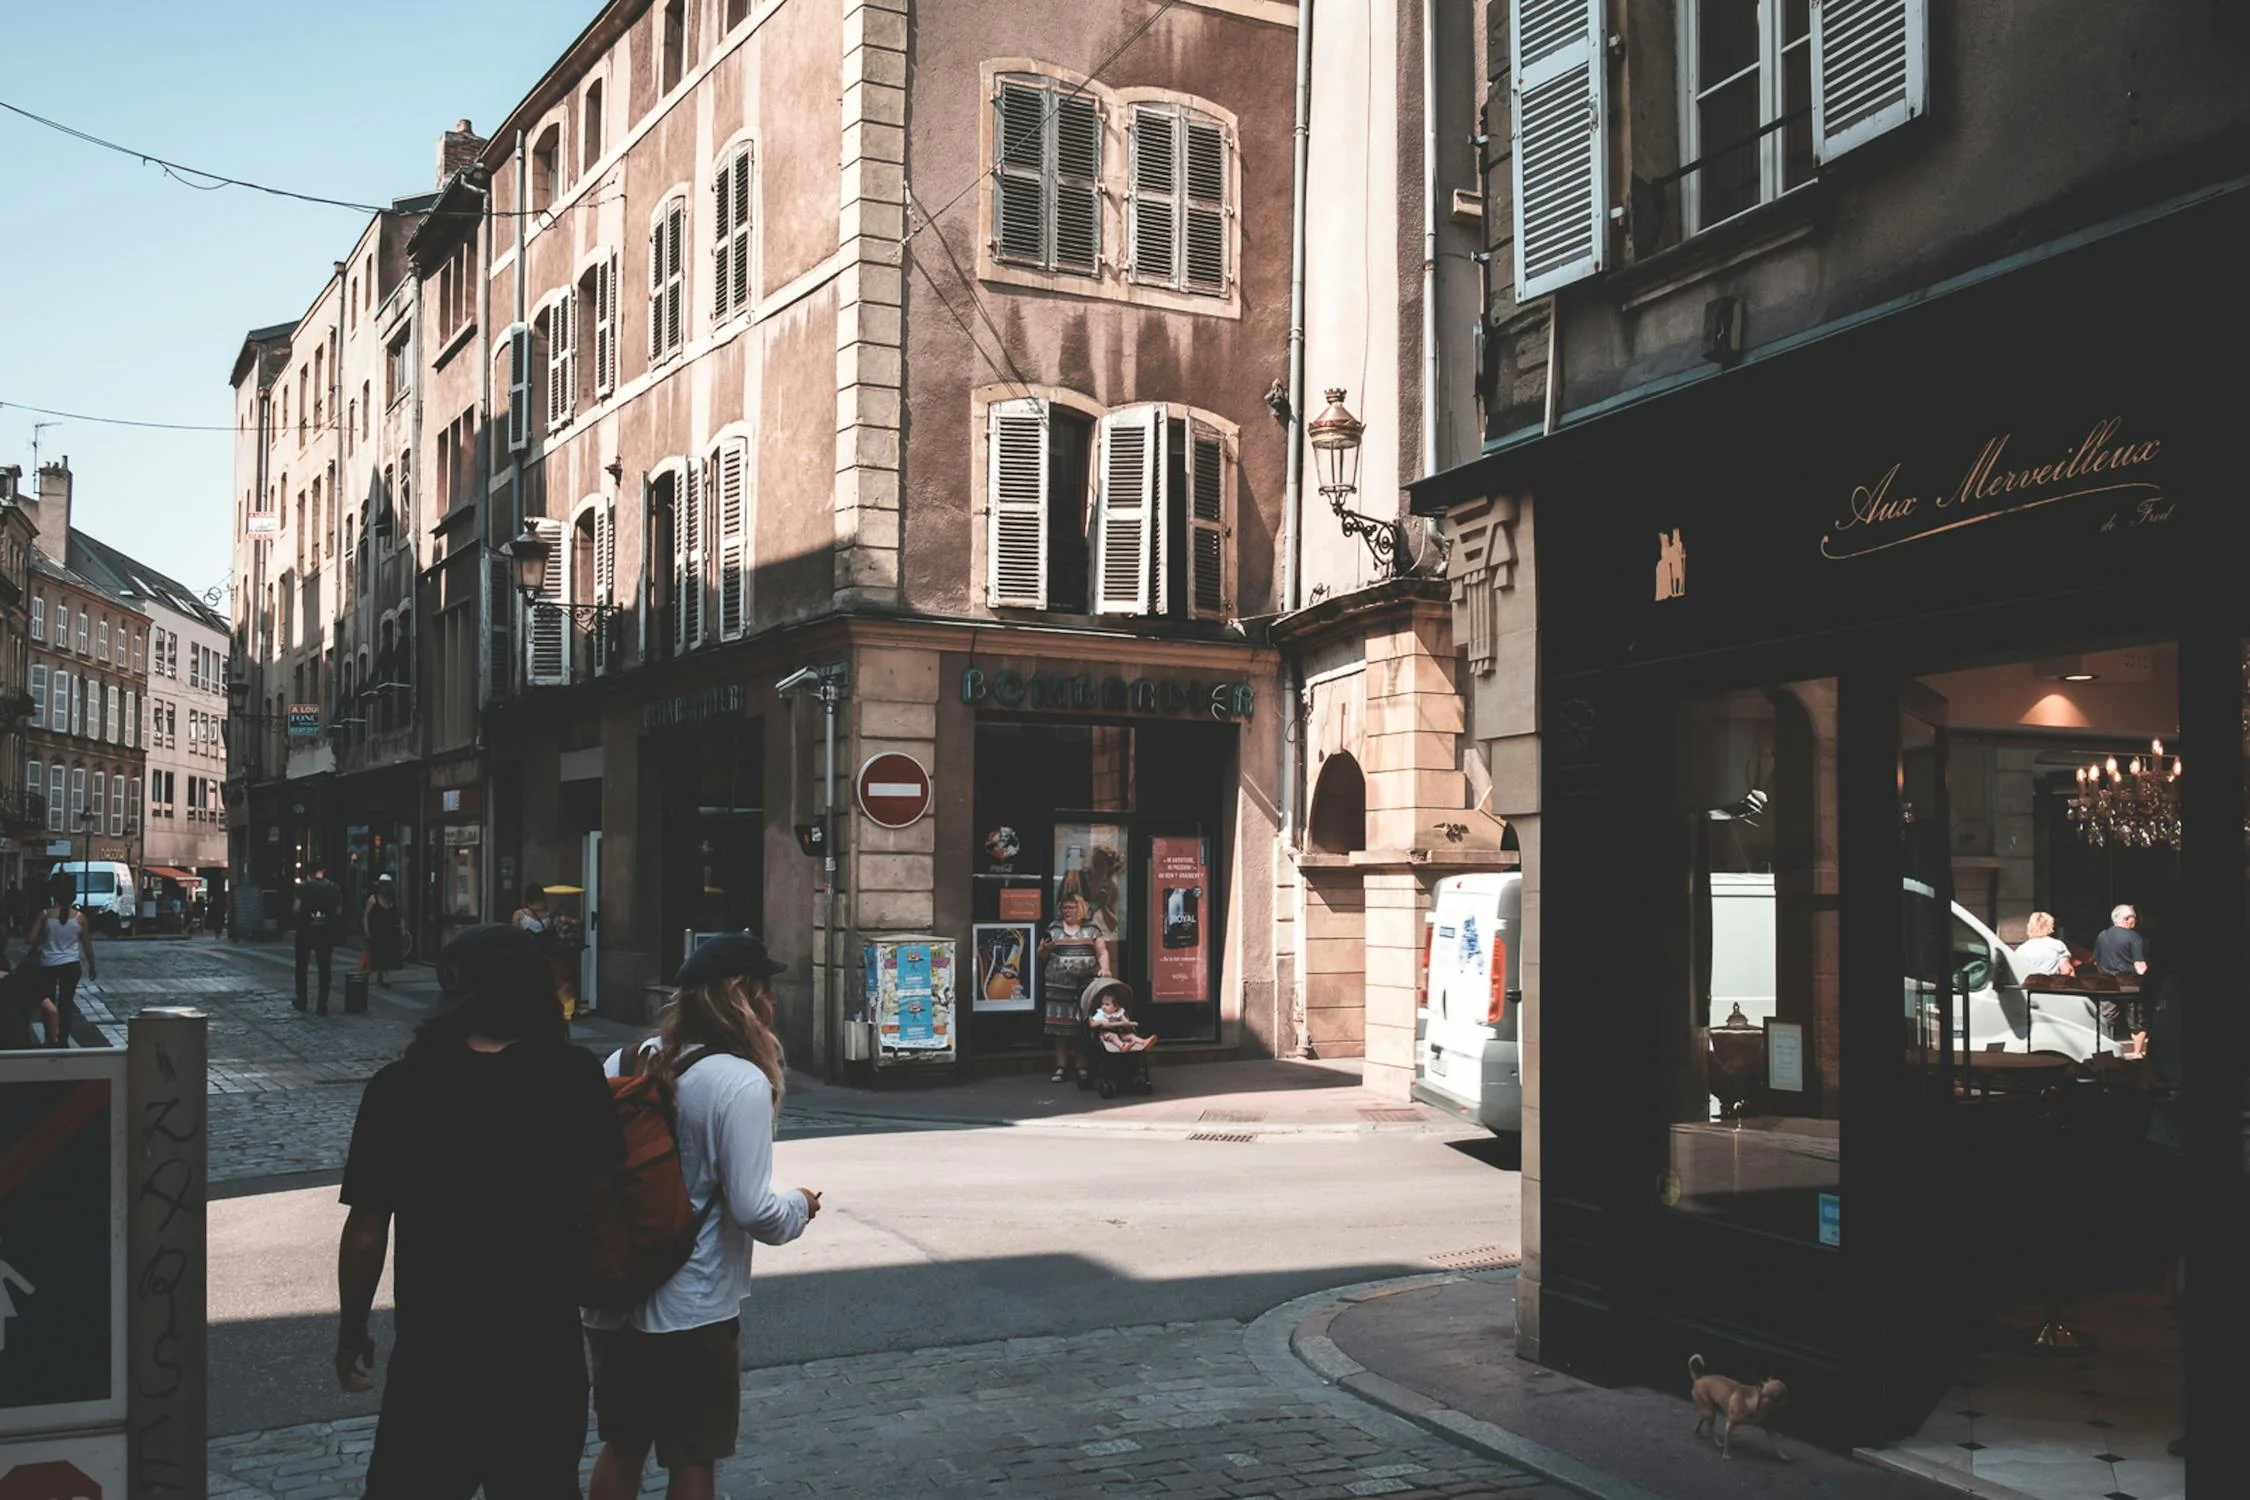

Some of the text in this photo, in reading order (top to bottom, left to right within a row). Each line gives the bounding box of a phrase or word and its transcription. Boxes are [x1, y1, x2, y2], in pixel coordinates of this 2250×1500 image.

[1835, 415, 2161, 530] Aux Merveilleux
[2099, 496, 2178, 534] de Fred
